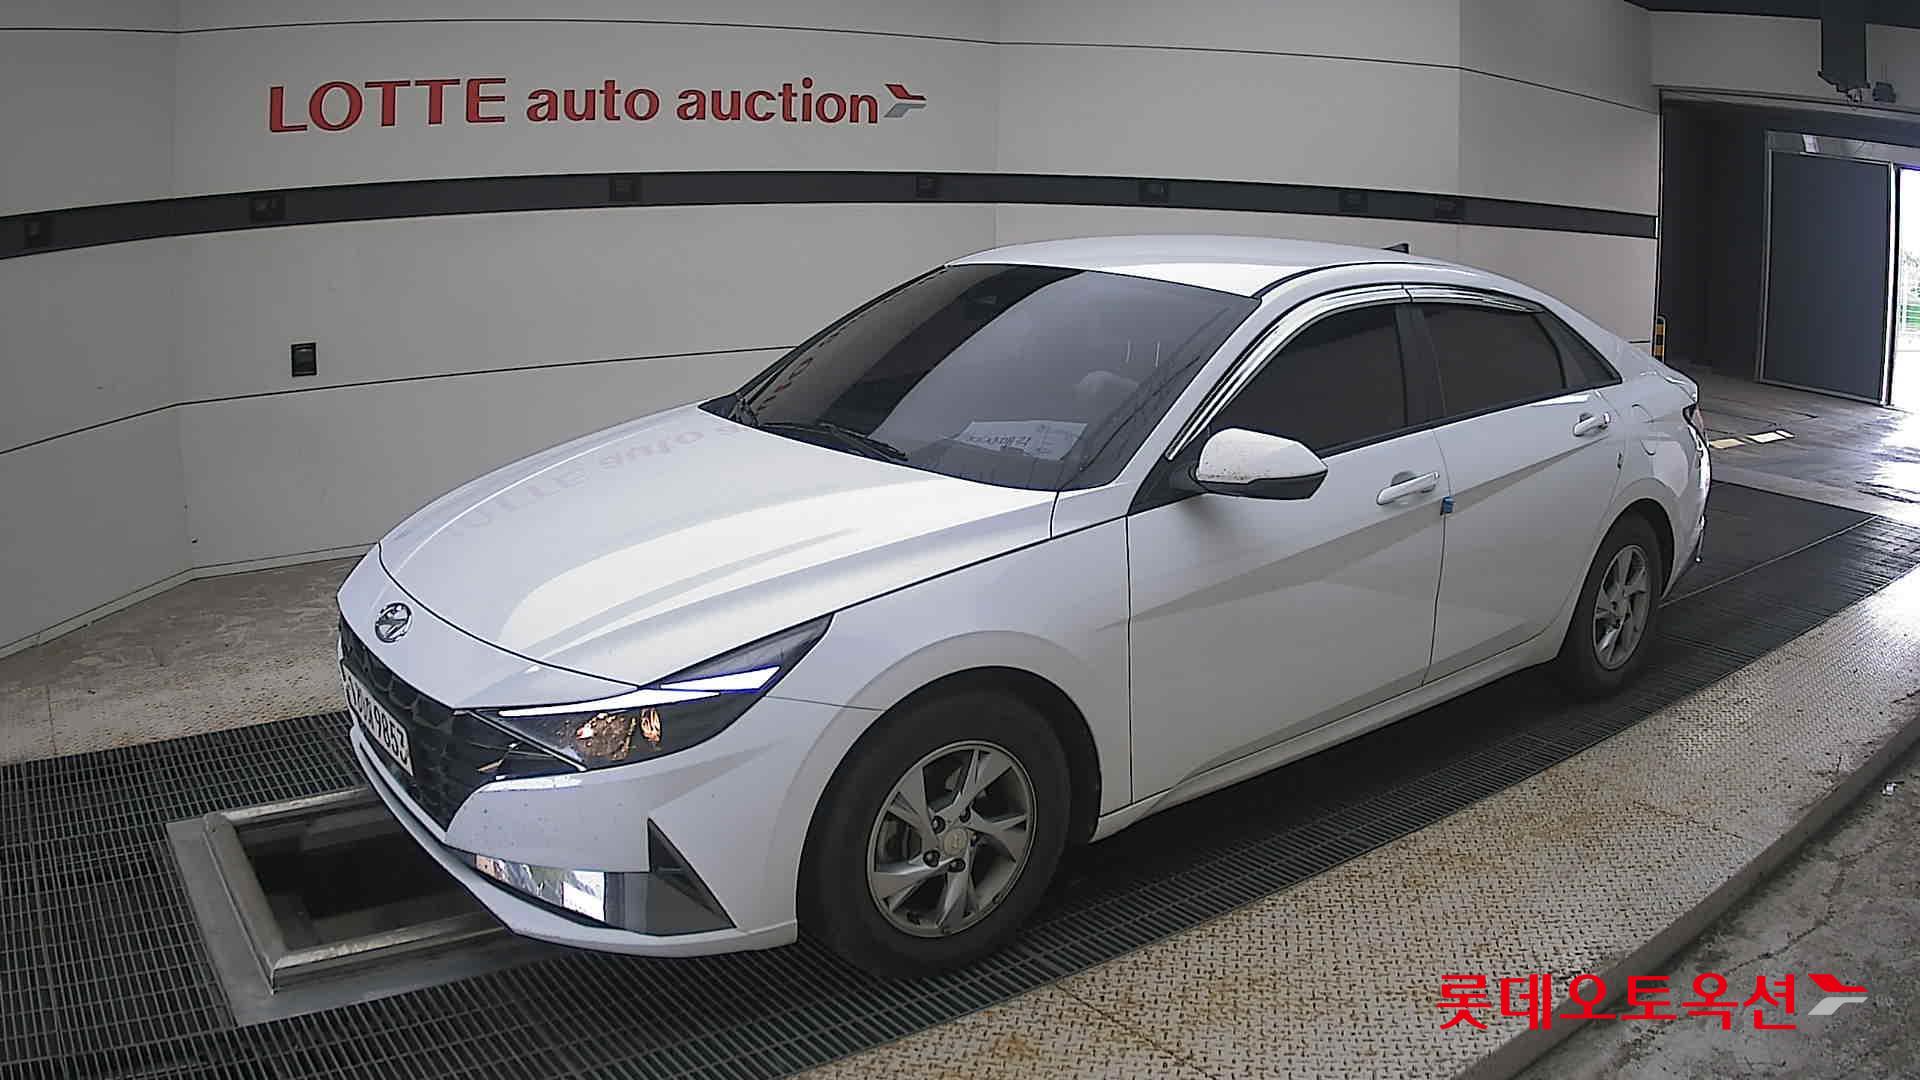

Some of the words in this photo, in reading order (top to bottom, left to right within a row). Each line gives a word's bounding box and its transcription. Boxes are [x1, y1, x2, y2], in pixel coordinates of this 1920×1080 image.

[269, 77, 506, 133] LOTTE
[527, 80, 660, 123] auto
[676, 78, 880, 125] auction
